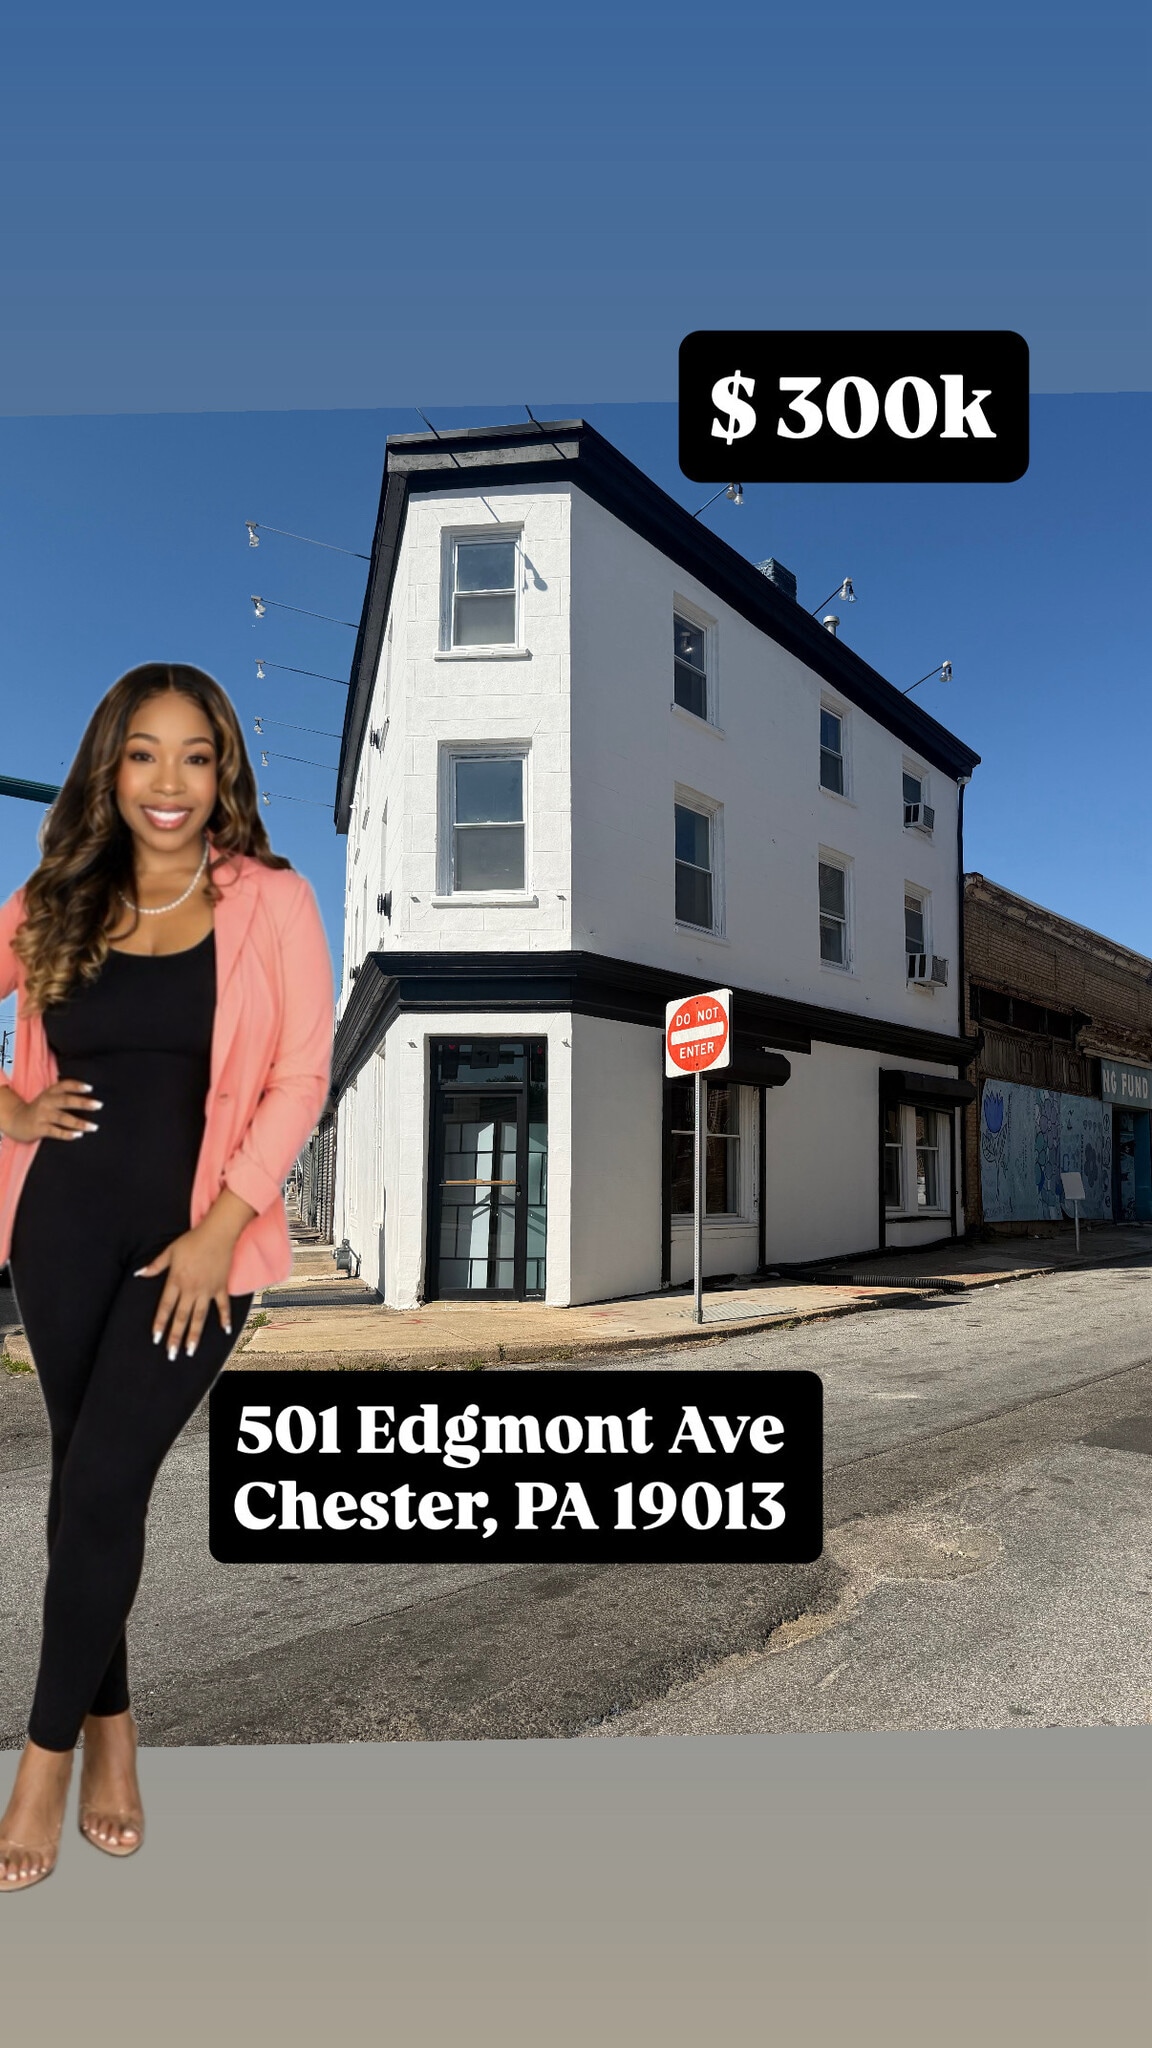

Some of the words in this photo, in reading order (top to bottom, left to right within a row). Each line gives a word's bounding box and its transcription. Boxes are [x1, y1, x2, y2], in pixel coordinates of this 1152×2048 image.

[676, 1013, 691, 1027] DO
[697, 1007, 719, 1022] NOT
[679, 1042, 714, 1059] ENTER
[1102, 1069, 1116, 1094] NG
[1121, 1073, 1148, 1098] FUND
